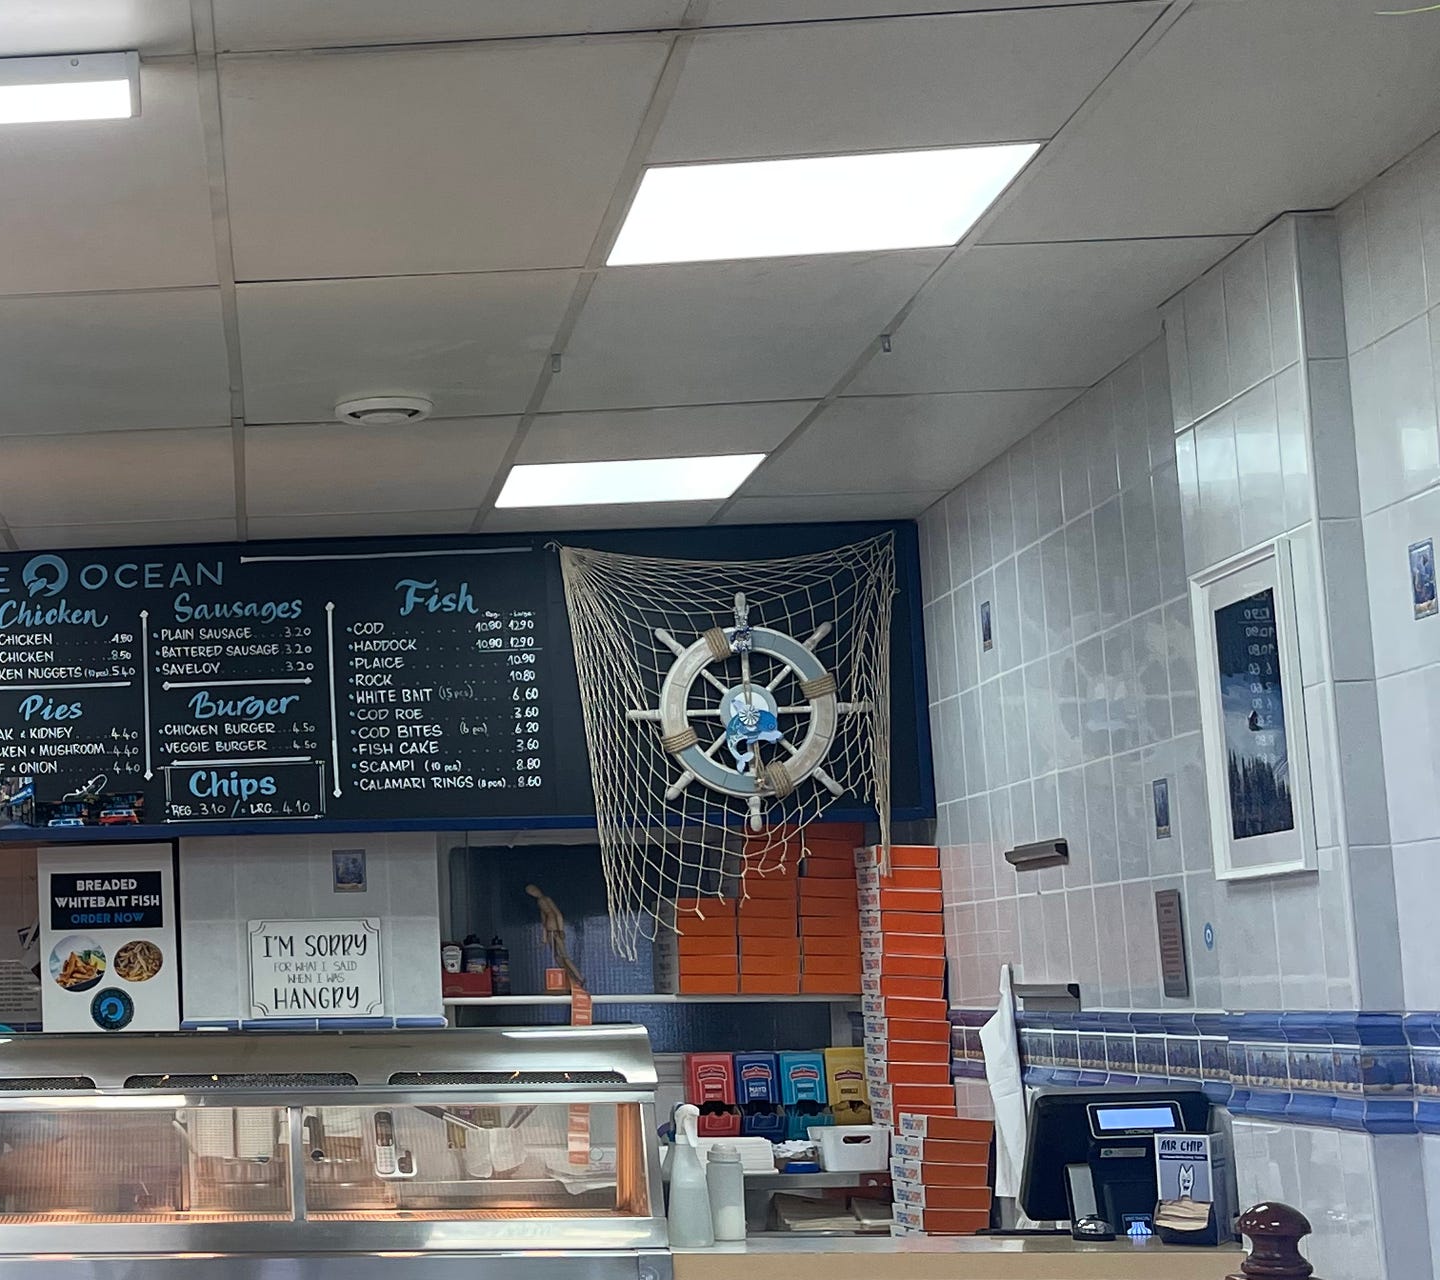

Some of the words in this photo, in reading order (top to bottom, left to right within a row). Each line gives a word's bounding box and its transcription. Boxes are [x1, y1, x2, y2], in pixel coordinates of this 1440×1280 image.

[79, 561, 223, 590] OCEAN
[395, 579, 479, 616] Fish
[174, 592, 303, 624] Sausages
[161, 627, 194, 641] PLAIN
[199, 626, 253, 640] SAUSAGE
[353, 622, 384, 635] COD
[161, 645, 223, 658] BATTERED
[225, 644, 280, 656] SAUSAGE
[354, 639, 417, 652] HADDOCK
[162, 662, 221, 675] SAVELOY
[354, 656, 405, 670] PLAICE
[28, 667, 82, 679] NUGGETS
[355, 674, 392, 687] ROCK
[356, 690, 397, 704] WHITE
[402, 688, 433, 703] BAIT
[19, 694, 83, 721] Pies
[188, 690, 300, 721] Burger
[357, 708, 389, 721] COD
[395, 708, 424, 720] ROE
[29, 726, 73, 739] KIDNEY
[164, 723, 218, 736] CHICKEN
[224, 722, 276, 735] BURGER
[358, 726, 390, 739] COD
[397, 725, 443, 738] BITES
[39, 743, 105, 756] MUSHROOM
[164, 741, 210, 754] VEGGIE
[216, 740, 268, 752] BURGER
[359, 743, 393, 756] FISH
[400, 740, 440, 754] CAKE
[19, 760, 58, 774] ONION
[359, 760, 415, 773] SCAMPI
[189, 770, 278, 802] Chips
[360, 778, 426, 791] CALAMARI
[431, 775, 474, 789] RINGS
[76, 878, 138, 892] BREADED
[55, 896, 128, 909] WHITEBAIT
[131, 895, 160, 907] FISH
[71, 913, 111, 924] ORDER
[114, 912, 144, 923] NOW
[262, 935, 295, 958] I'M
[305, 933, 367, 957] SORRY
[274, 962, 292, 973] FOR
[295, 961, 317, 972] WHAT
[321, 961, 326, 972] I
[334, 960, 357, 971] SAID
[288, 973, 313, 984] WHEN
[317, 973, 322, 984] I
[326, 972, 345, 984] WAS
[274, 986, 360, 1009] HANGRY
[1161, 1140, 1177, 1151] MR
[1180, 1140, 1203, 1152] CHIP
